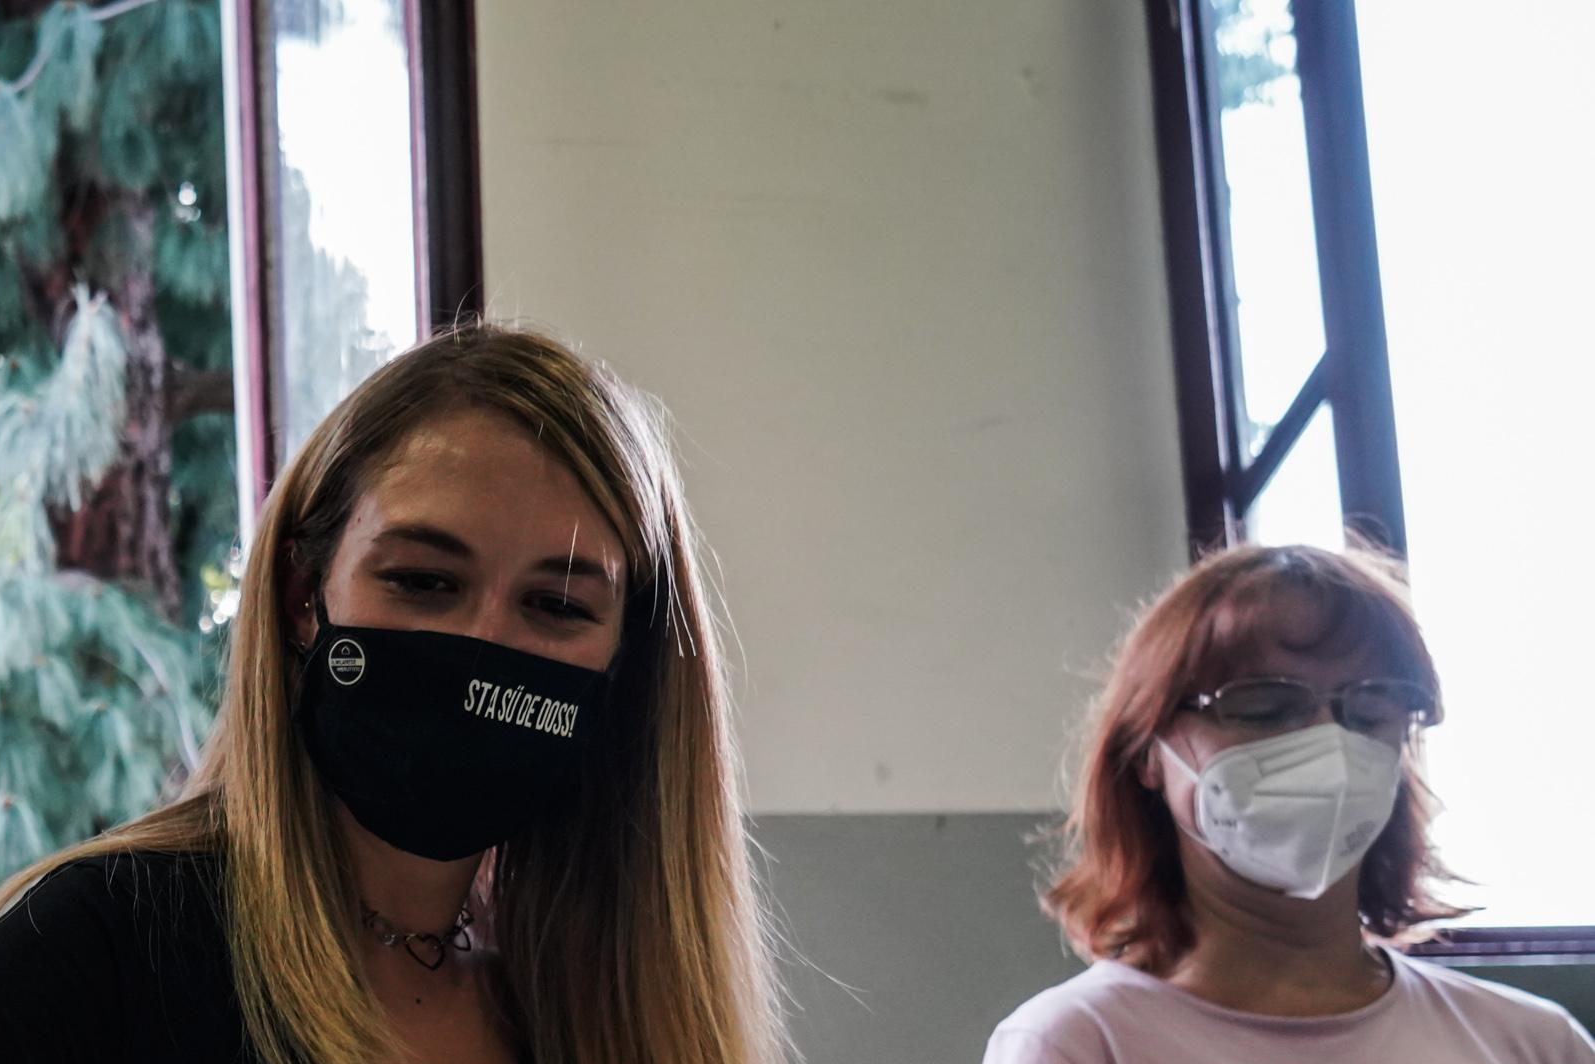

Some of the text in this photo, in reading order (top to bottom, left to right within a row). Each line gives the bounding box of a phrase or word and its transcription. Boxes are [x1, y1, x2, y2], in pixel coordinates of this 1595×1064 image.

[464, 679, 501, 719] STA
[515, 693, 542, 728] DE
[535, 698, 579, 738] DOSS!
